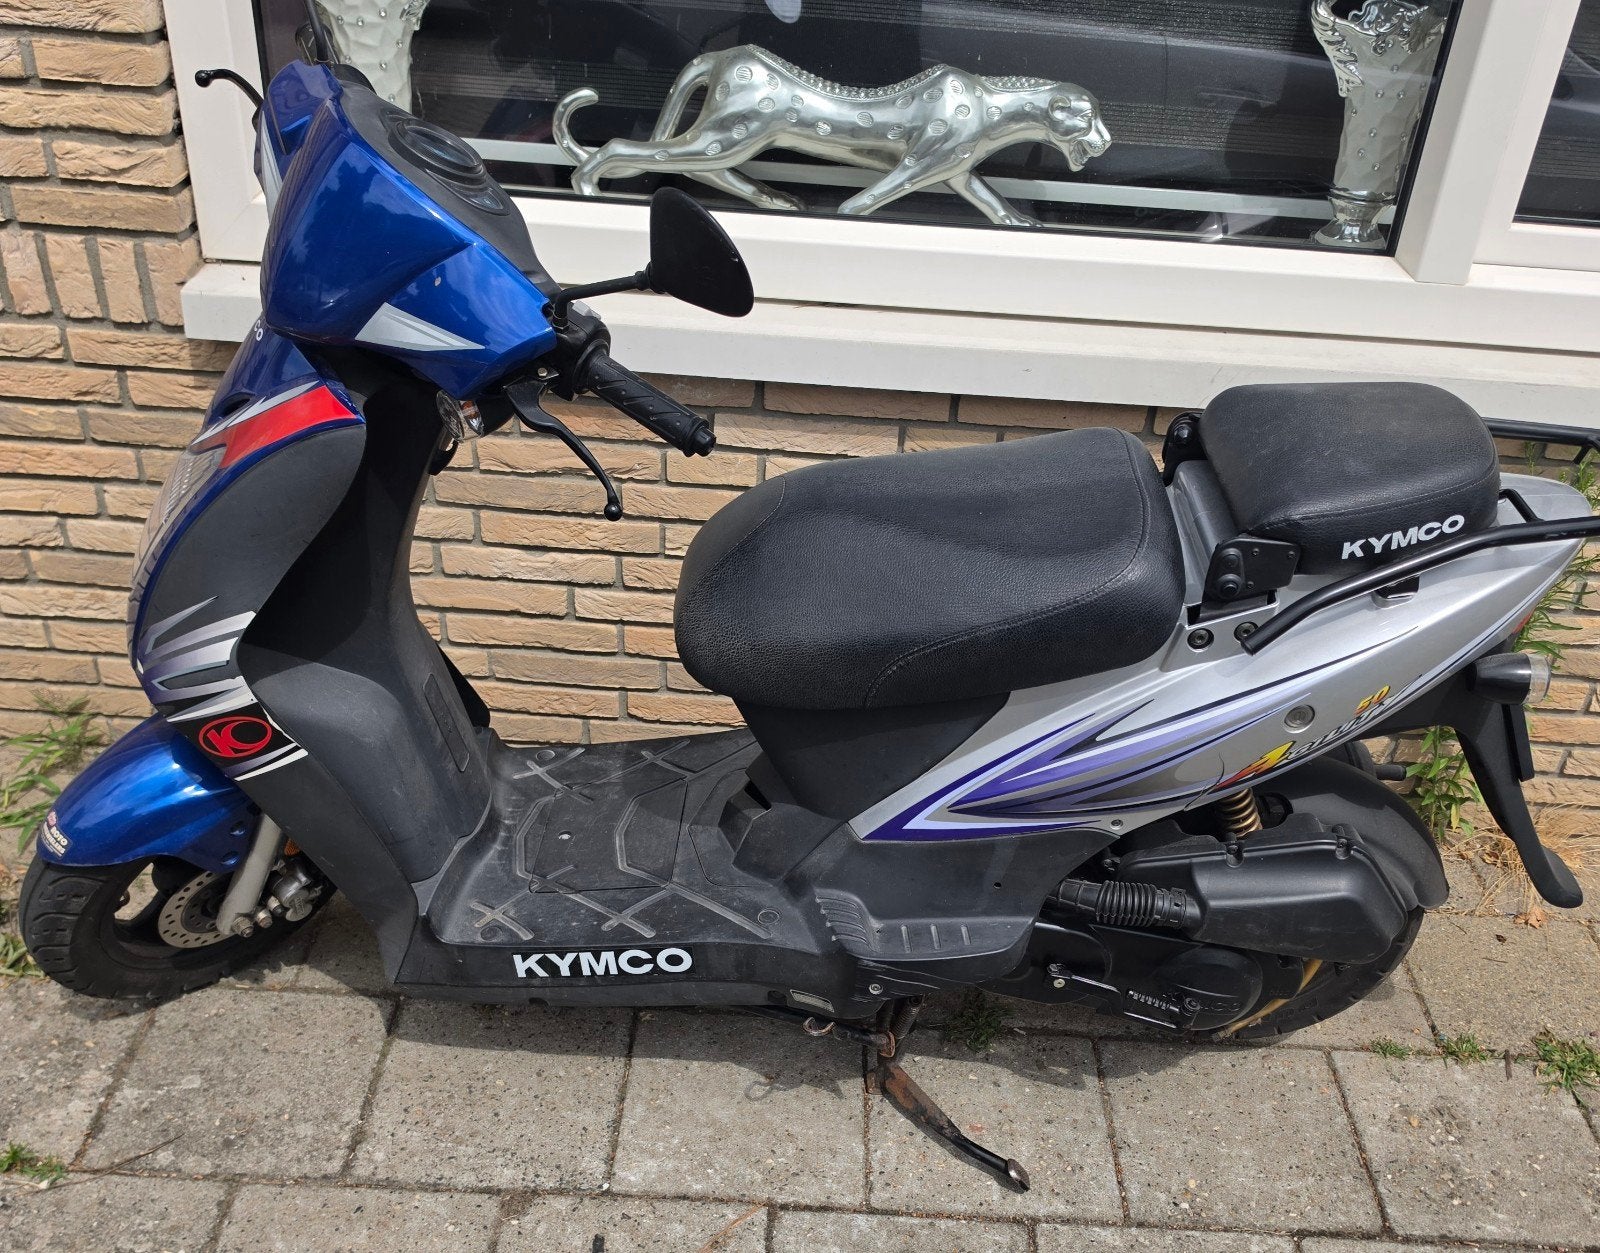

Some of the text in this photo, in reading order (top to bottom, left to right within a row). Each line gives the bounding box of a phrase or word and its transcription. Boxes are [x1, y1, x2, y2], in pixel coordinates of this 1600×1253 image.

[1341, 514, 1465, 560] KYMCO
[1354, 685, 1391, 716] 50
[512, 947, 693, 978] KYMCO
